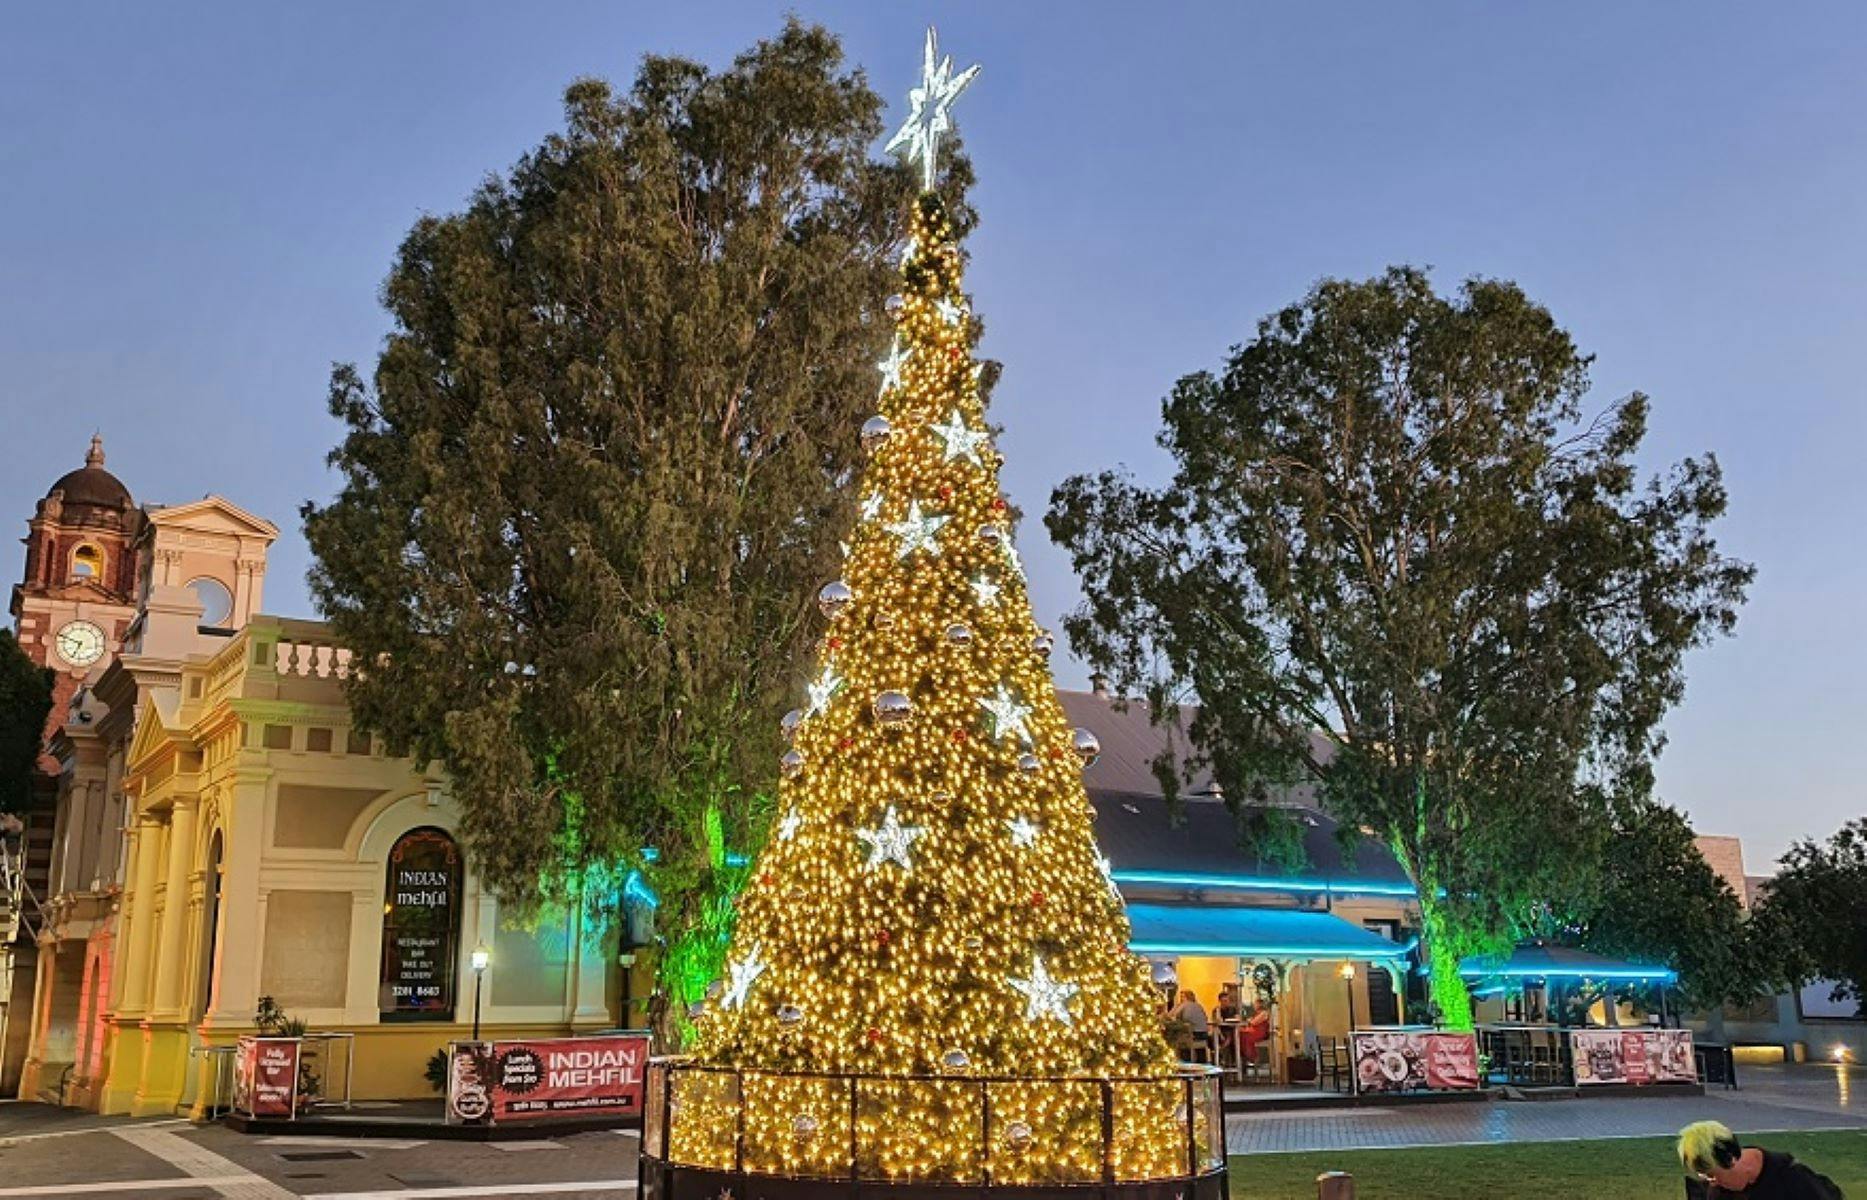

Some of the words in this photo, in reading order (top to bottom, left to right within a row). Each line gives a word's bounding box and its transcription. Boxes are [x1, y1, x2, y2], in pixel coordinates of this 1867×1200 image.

[399, 870, 448, 886] INDIAN
[549, 1049, 636, 1070] INDIAN
[548, 1067, 642, 1088] MEHFIL
